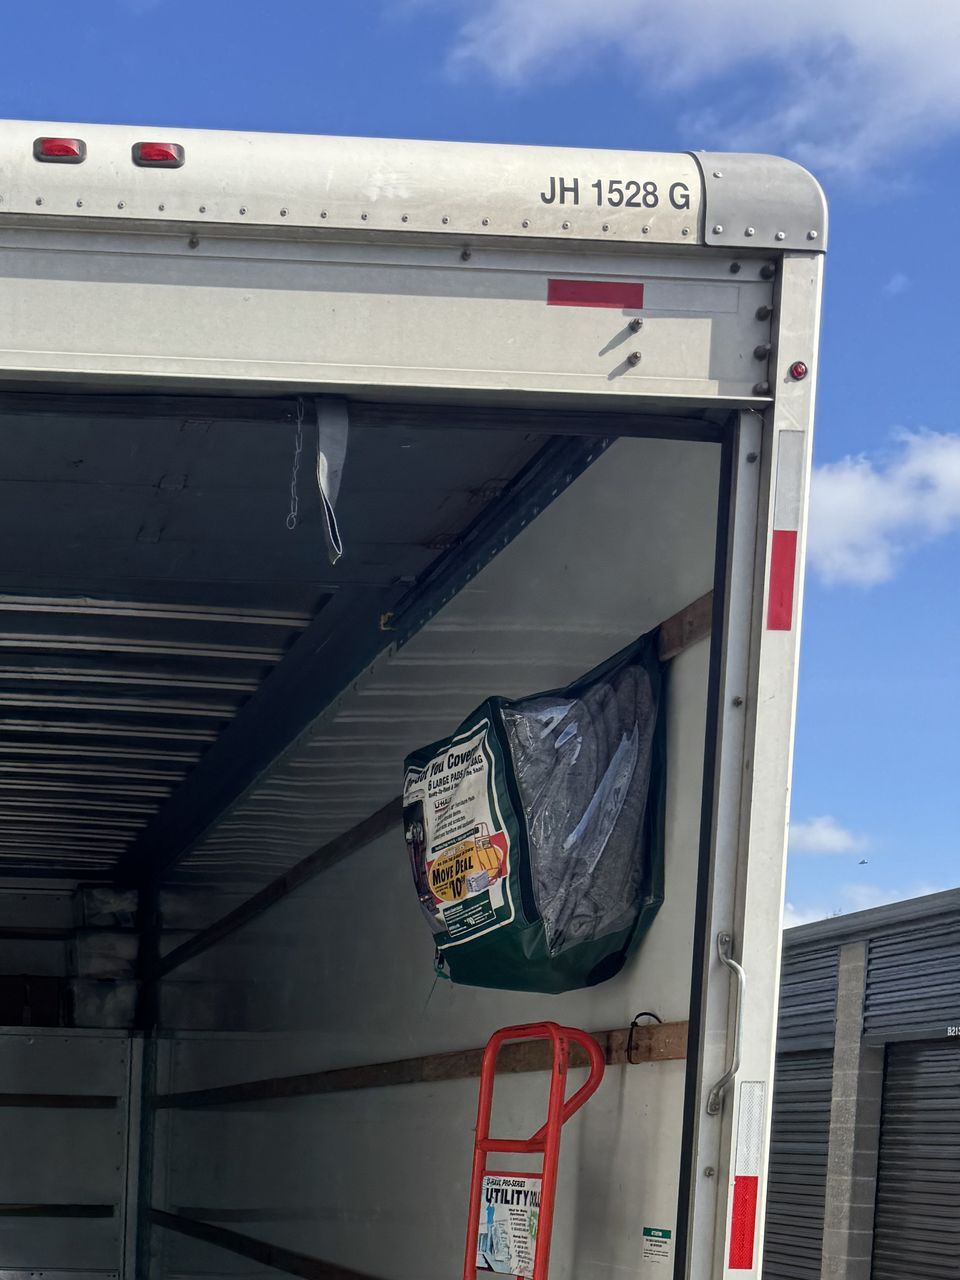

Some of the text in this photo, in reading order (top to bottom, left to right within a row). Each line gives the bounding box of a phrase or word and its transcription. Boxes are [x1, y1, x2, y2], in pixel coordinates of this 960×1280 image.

[541, 177, 690, 209] JH 1528 G
[433, 775, 449, 789] LARGE
[432, 865, 453, 886] MOVE
[456, 856, 474, 876] DEAL
[486, 1187, 529, 1206] UTILITY
